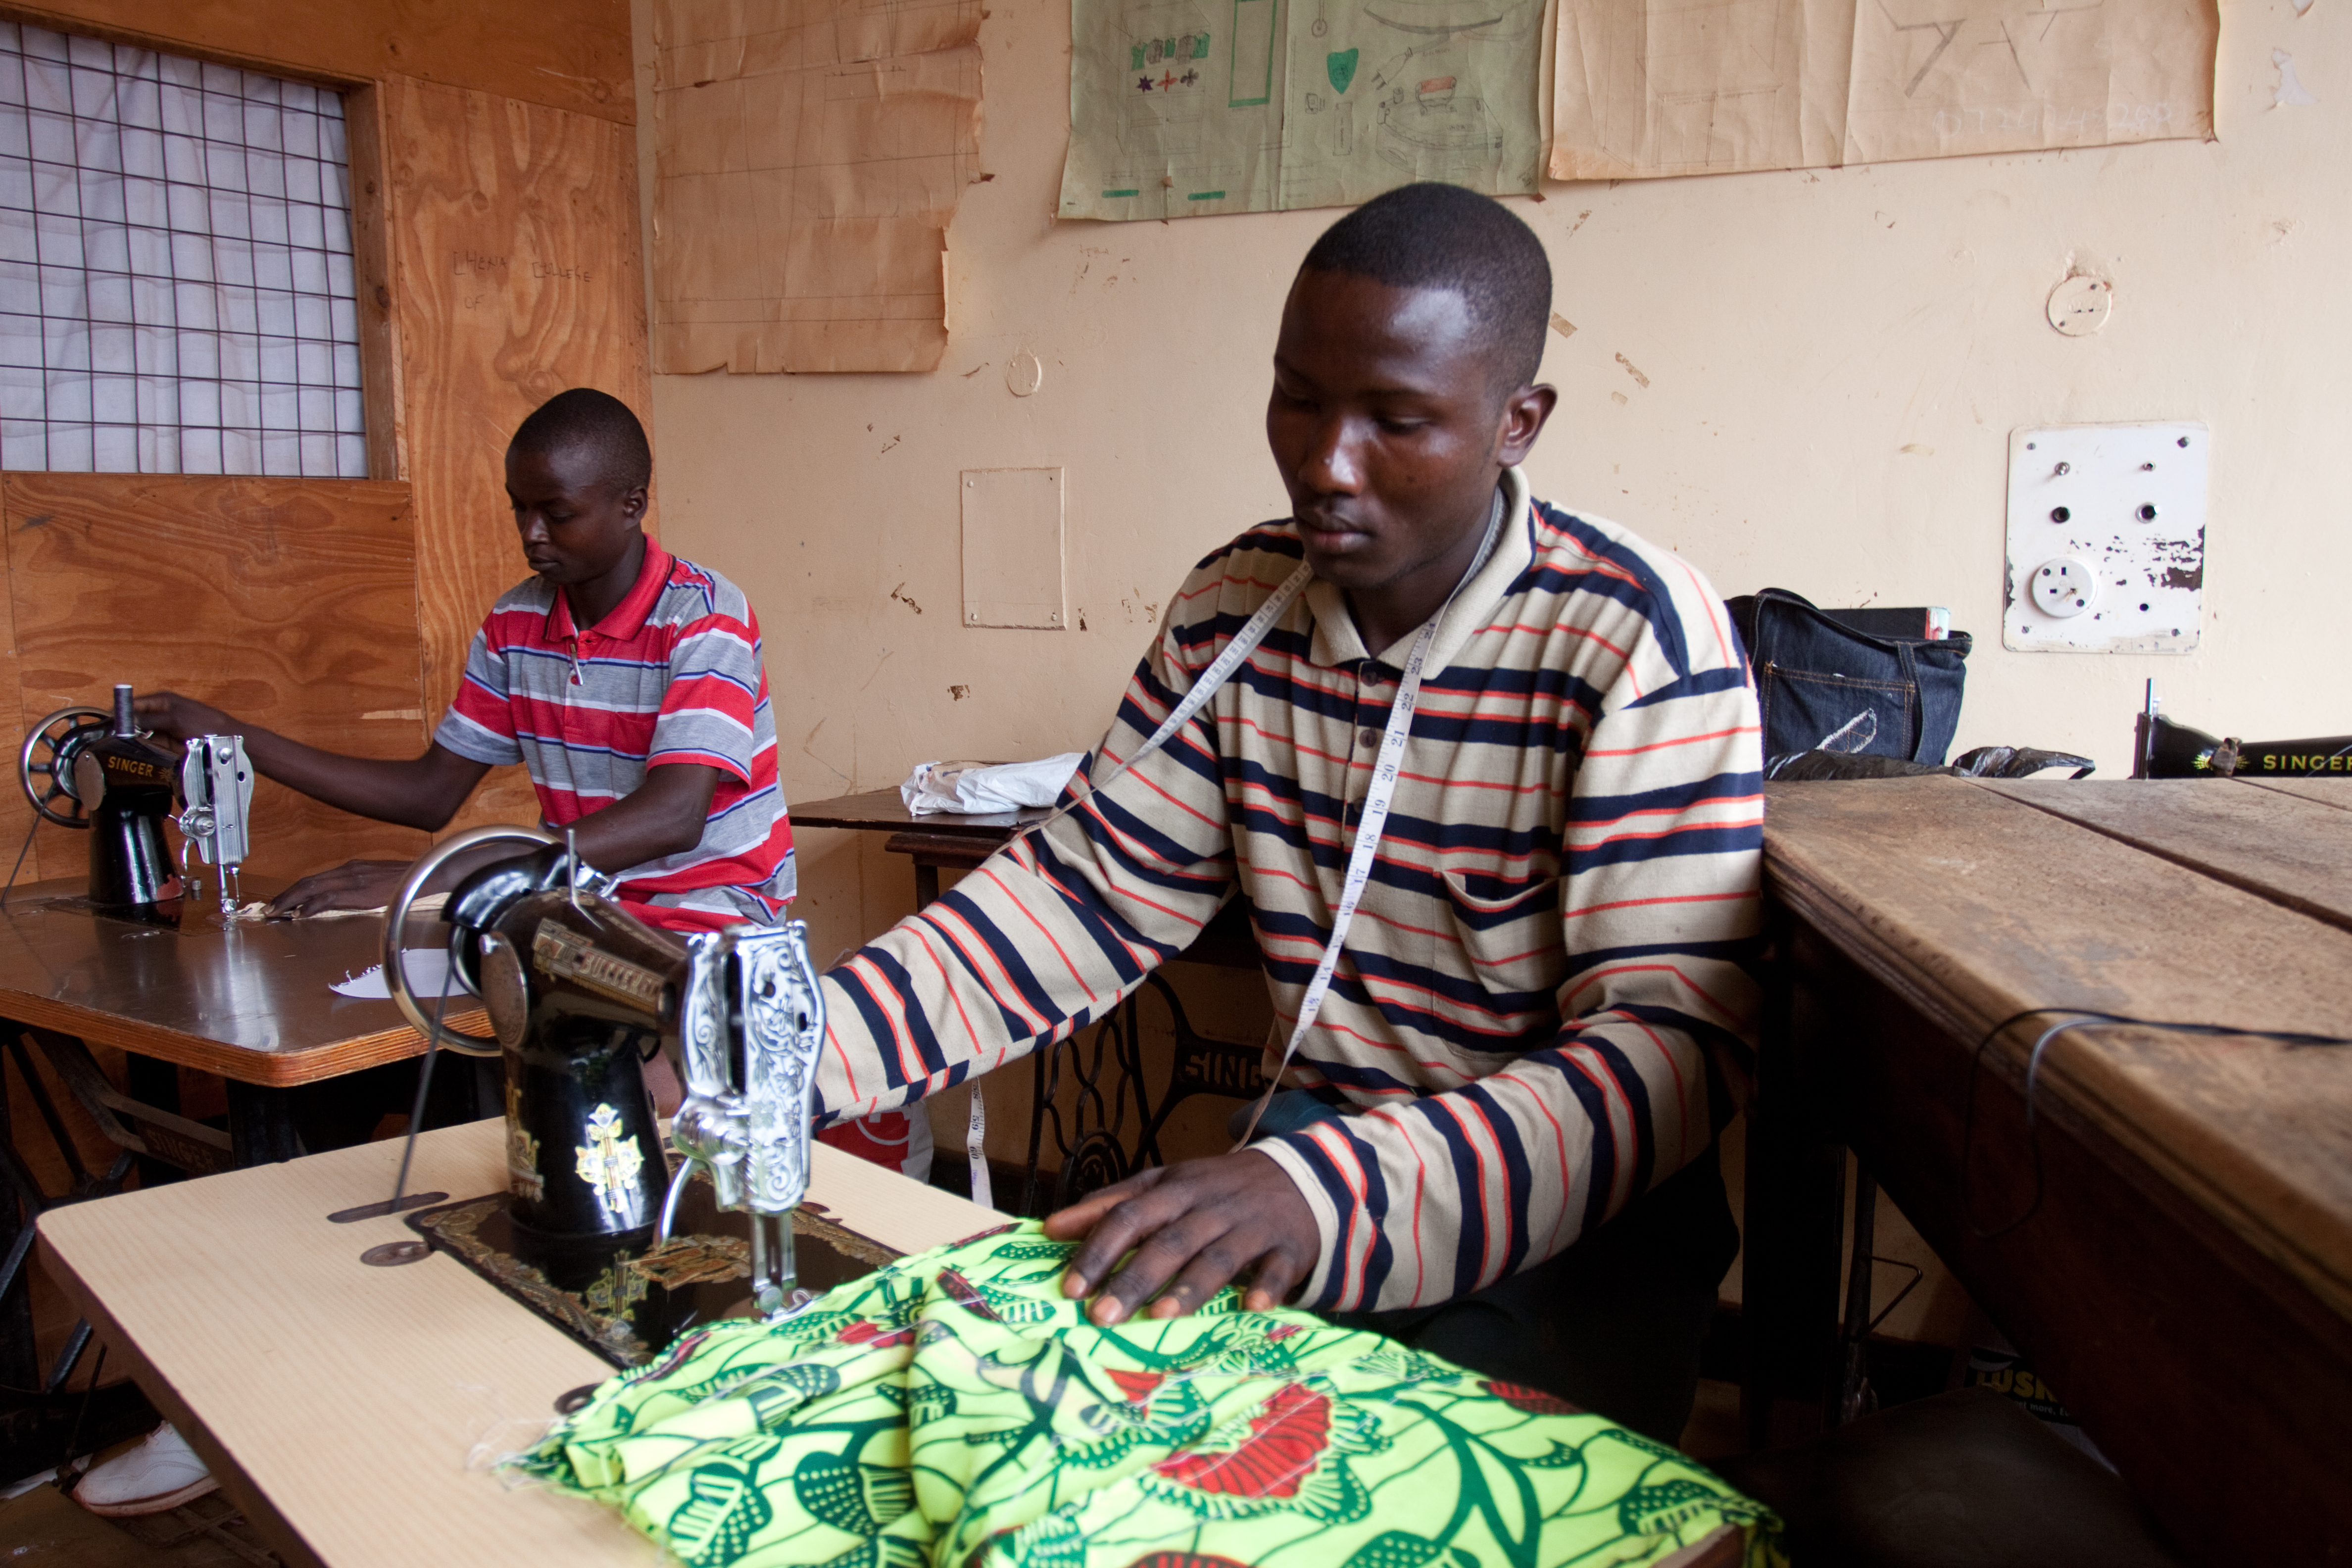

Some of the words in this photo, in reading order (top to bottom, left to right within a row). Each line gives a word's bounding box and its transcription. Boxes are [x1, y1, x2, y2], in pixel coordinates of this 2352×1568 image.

[1424, 622, 1436, 639] 24
[1411, 657, 1423, 675] 23
[1401, 693, 1414, 712] 22
[1391, 730, 1405, 747] 21
[108, 756, 154, 778] SINGER
[1381, 764, 1396, 782] 20
[1372, 799, 1386, 815] 19
[1363, 833, 1376, 849] 18
[1354, 869, 1366, 883] 17
[971, 1115, 980, 1130] 59
[969, 1146, 979, 1159] 60
